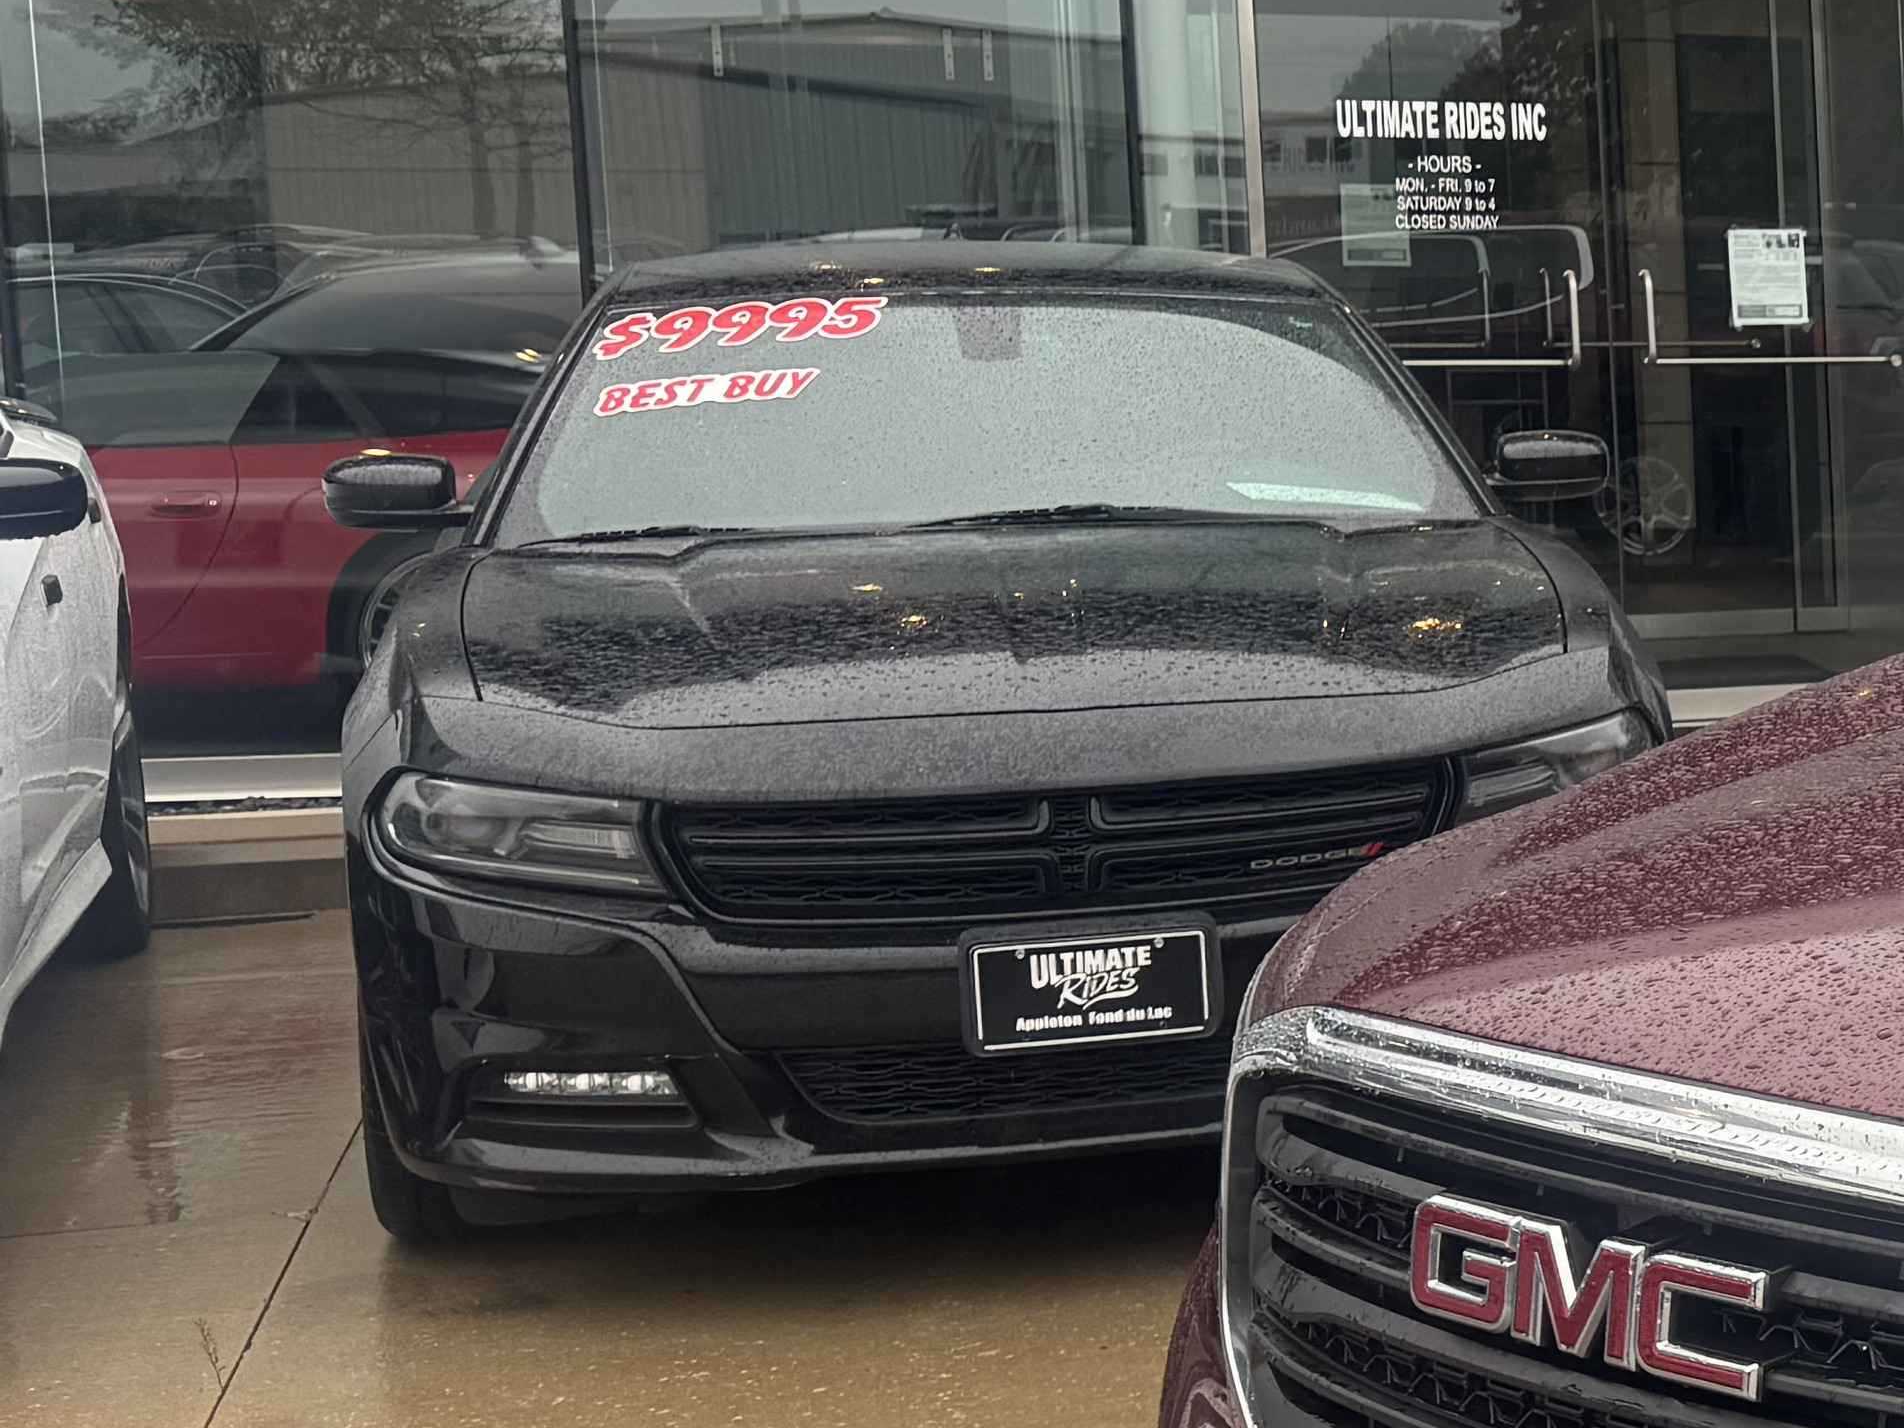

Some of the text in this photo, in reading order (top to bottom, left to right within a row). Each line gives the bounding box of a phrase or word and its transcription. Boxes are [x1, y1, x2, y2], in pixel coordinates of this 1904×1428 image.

[1336, 99, 1548, 141] ULTIMATE RIDES INC
[1417, 156, 1473, 173] HOURS
[1396, 176, 1429, 193] MON.
[1439, 178, 1462, 193] FRI.
[1465, 178, 1472, 193] 9
[1475, 178, 1486, 193] to
[1489, 178, 1496, 192] 7
[1397, 196, 1496, 211] SATURDAY 9 to 4
[1395, 214, 1499, 230] CLOSED SUNDAY
[594, 296, 888, 360] $9995
[595, 368, 820, 416] BEST BUY
[1250, 847, 1364, 869] DODGE
[1030, 945, 1152, 990] ULTIMATE
[1016, 1005, 1173, 1032] Appleton Fond du Lac
[1411, 1194, 1772, 1402] GMC
